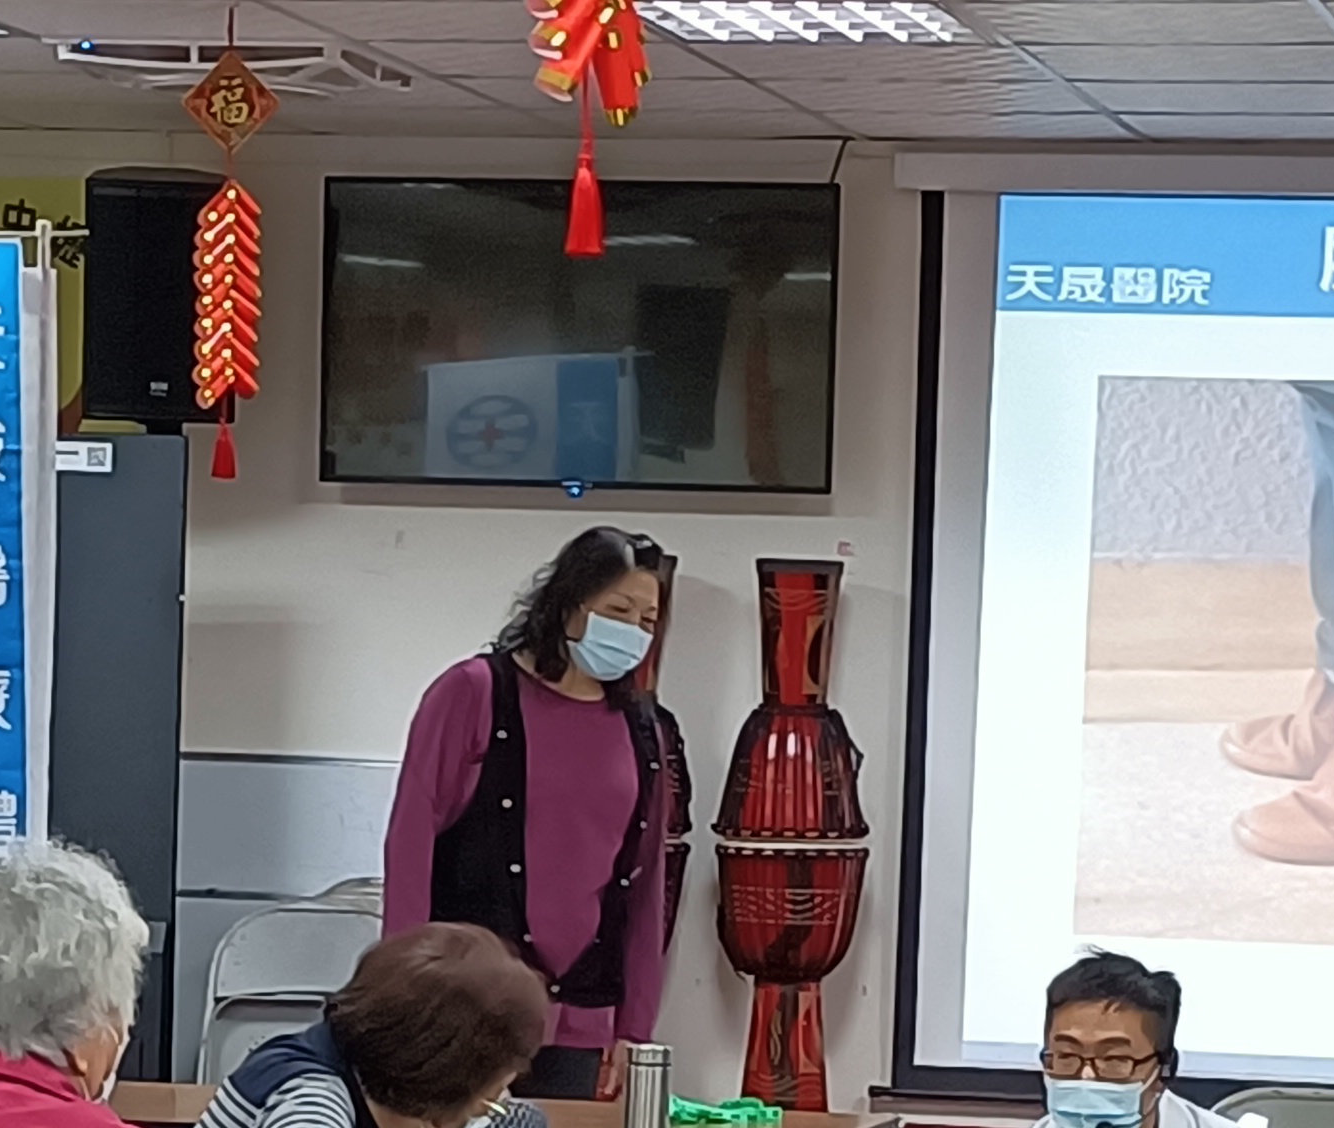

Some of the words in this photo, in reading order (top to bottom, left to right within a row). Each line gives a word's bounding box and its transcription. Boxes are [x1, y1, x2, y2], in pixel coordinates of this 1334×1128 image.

[210, 77, 249, 124] 福
[1005, 263, 1213, 306] 天晟醫院
